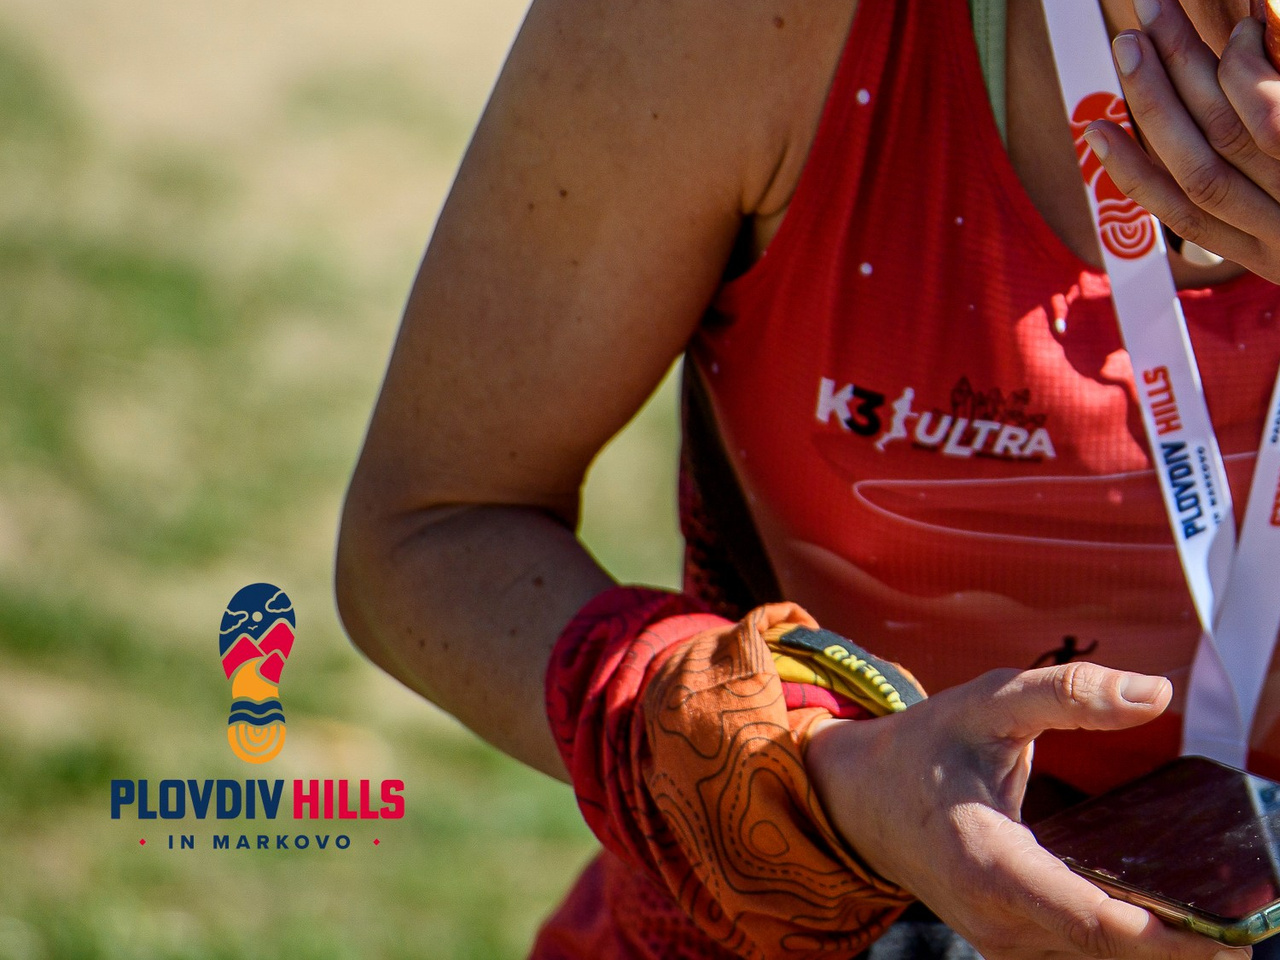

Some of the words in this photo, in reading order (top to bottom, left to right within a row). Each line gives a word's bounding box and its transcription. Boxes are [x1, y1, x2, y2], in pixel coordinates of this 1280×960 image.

[815, 376, 885, 436] K3
[914, 411, 1057, 458] ULTRA
[1143, 365, 1183, 436] HILLS
[1161, 441, 1207, 539] PLOVDIV
